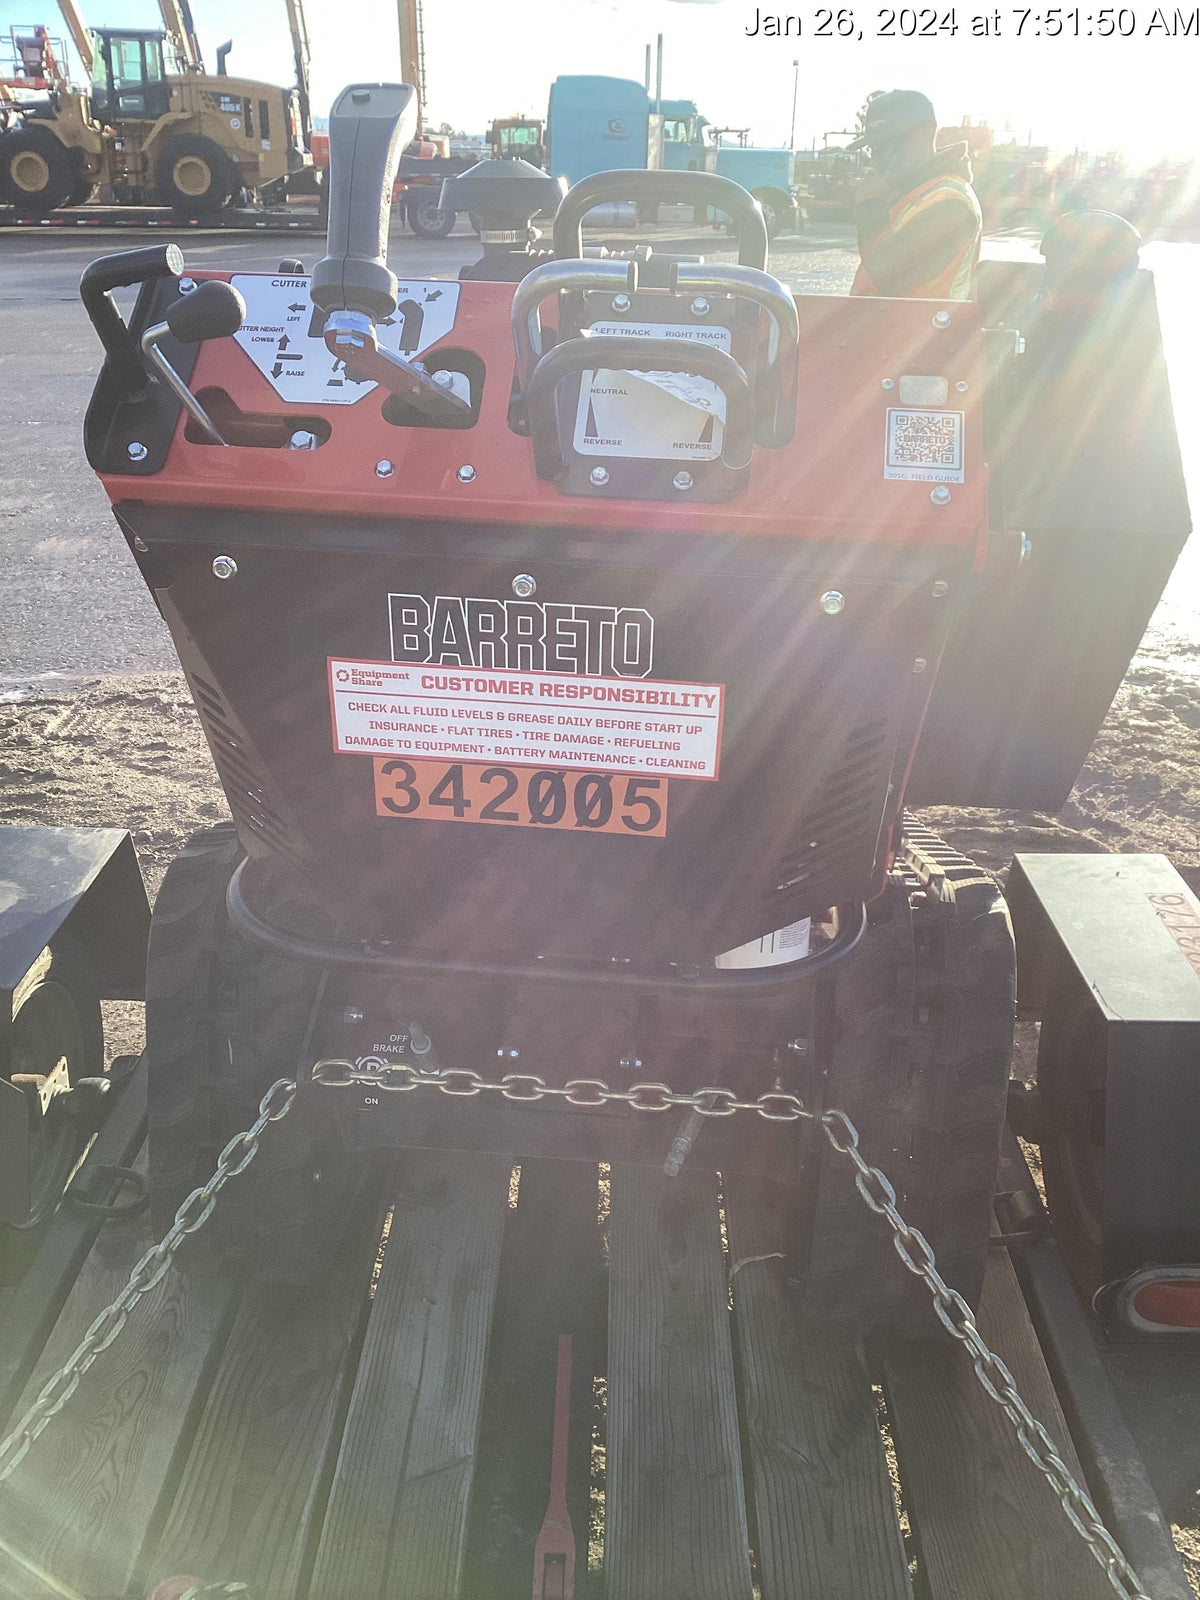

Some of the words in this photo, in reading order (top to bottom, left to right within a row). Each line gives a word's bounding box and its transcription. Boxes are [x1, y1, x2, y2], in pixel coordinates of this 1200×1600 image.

[271, 279, 307, 288] CUTTER
[620, 328, 651, 336] TRACK
[665, 330, 693, 339] RIGHT
[696, 332, 728, 340] TRACK
[590, 387, 629, 396] NEUTRAL
[583, 438, 623, 446] REVERSE
[672, 442, 713, 450] REVERSE
[934, 475, 961, 483] GUIDE
[387, 592, 655, 680] BARRETO
[351, 668, 410, 680] Equipment
[351, 677, 383, 687] Share
[421, 675, 534, 696] CUSTOMER
[539, 682, 716, 709] RESPONSIBILITY
[348, 701, 387, 713] CHECK
[390, 704, 411, 715] ALL
[413, 706, 449, 718] FLUID
[451, 709, 493, 720] LEVELS
[508, 712, 554, 725] GREASE
[557, 716, 593, 727] DAILY
[595, 719, 642, 731] BEFORE
[644, 723, 683, 734] START
[686, 725, 703, 735] UP
[369, 720, 438, 733] INSURANCE
[447, 725, 475, 736] FLAT
[477, 727, 513, 739] TIRES
[522, 730, 551, 742] TIRE
[553, 733, 604, 746] DAMAGE
[614, 738, 681, 751] REFUELING
[345, 735, 394, 748] DAMAGE
[397, 739, 412, 749] TO
[415, 740, 485, 754] EQUIPMENT
[494, 746, 546, 758] BATTERY
[549, 749, 636, 765] MAINTENANCE
[646, 757, 706, 770] CLEANING
[389, 1034, 408, 1043] OFF
[372, 1043, 406, 1054] BRAKE
[364, 1097, 379, 1105] ON
